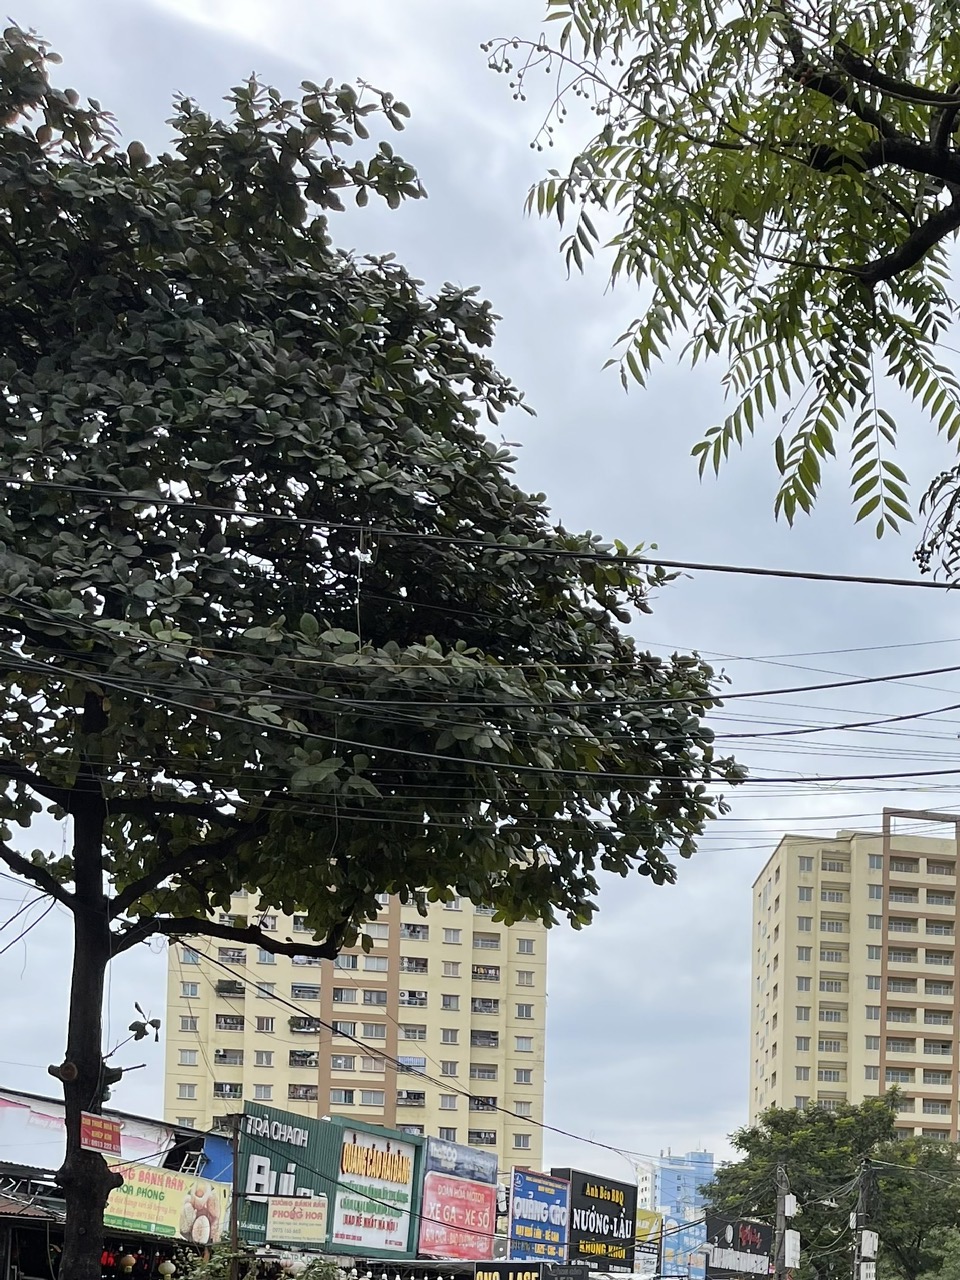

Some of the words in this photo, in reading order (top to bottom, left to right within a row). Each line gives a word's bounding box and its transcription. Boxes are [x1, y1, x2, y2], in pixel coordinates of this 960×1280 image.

[246, 1114, 270, 1138] TRÀ
[429, 1202, 441, 1220] XE
[443, 1205, 457, 1223] GA
[464, 1208, 476, 1226] XE
[477, 1206, 490, 1228] SỐ
[513, 1191, 549, 1222] QUẢNG
[549, 1199, 567, 1227] CÁO
